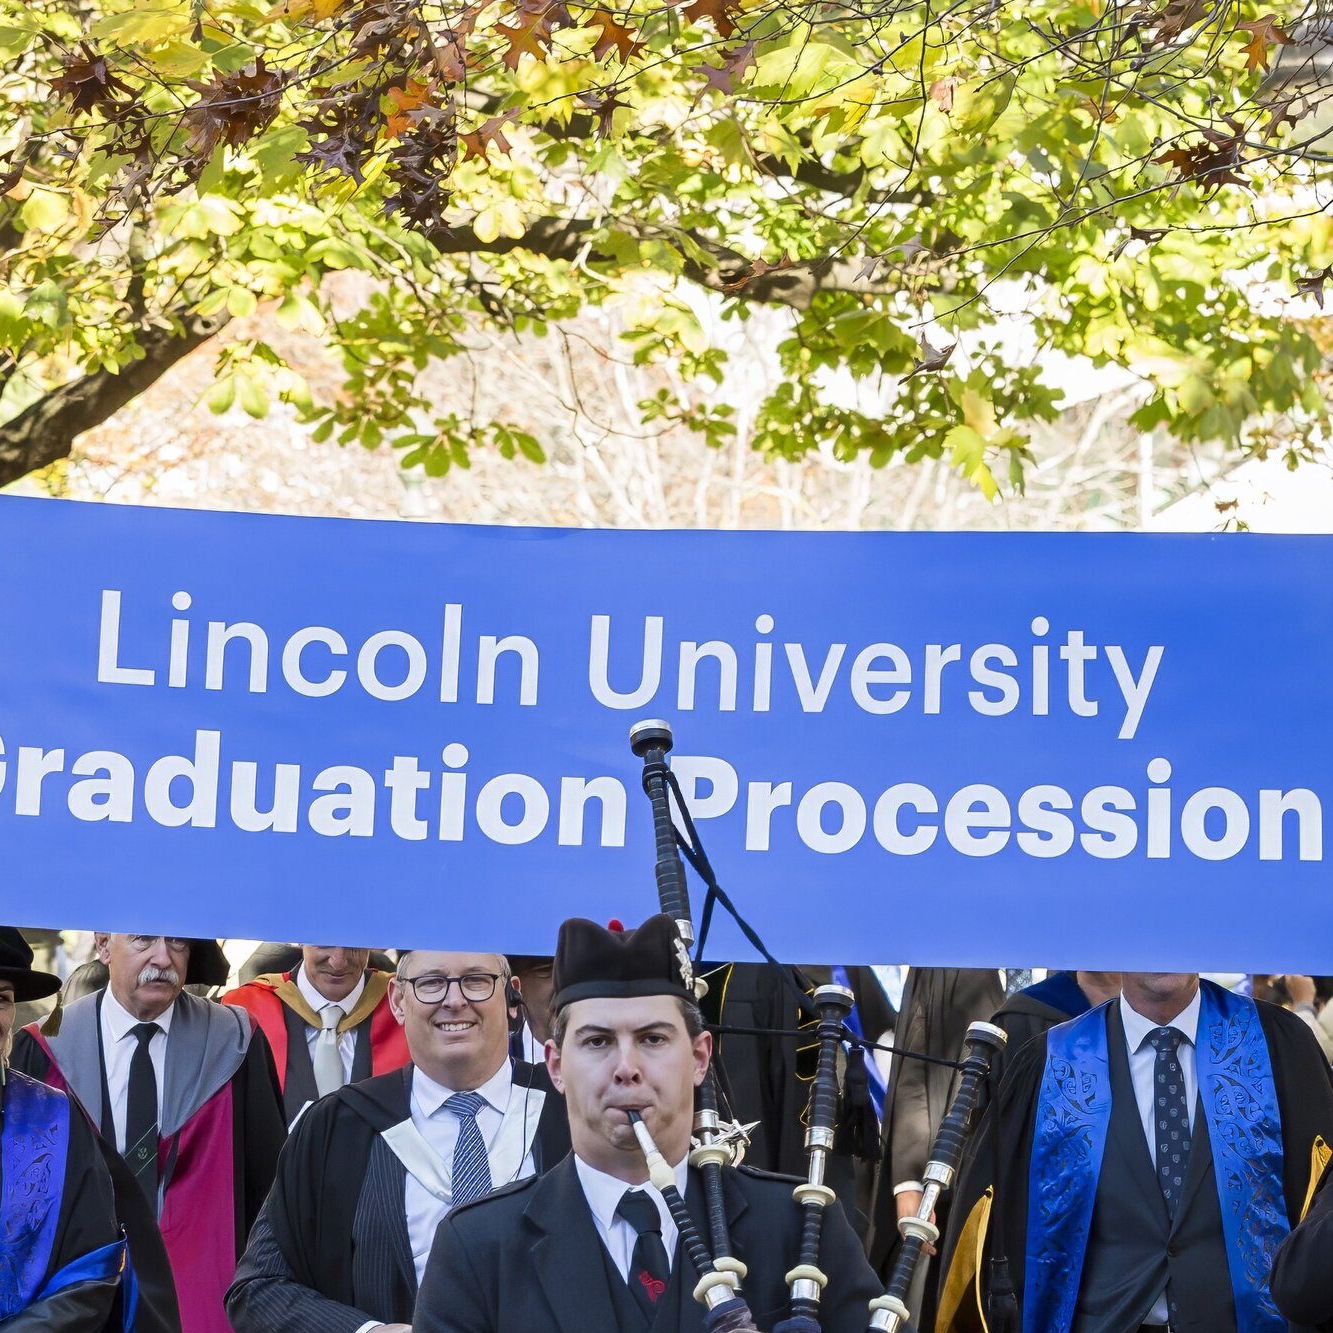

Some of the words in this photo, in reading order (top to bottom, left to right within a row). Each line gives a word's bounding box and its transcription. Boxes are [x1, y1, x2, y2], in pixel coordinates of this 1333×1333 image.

[97, 589, 540, 707] Lincoln
[588, 613, 1166, 740] University
[666, 754, 1324, 863] Procession
